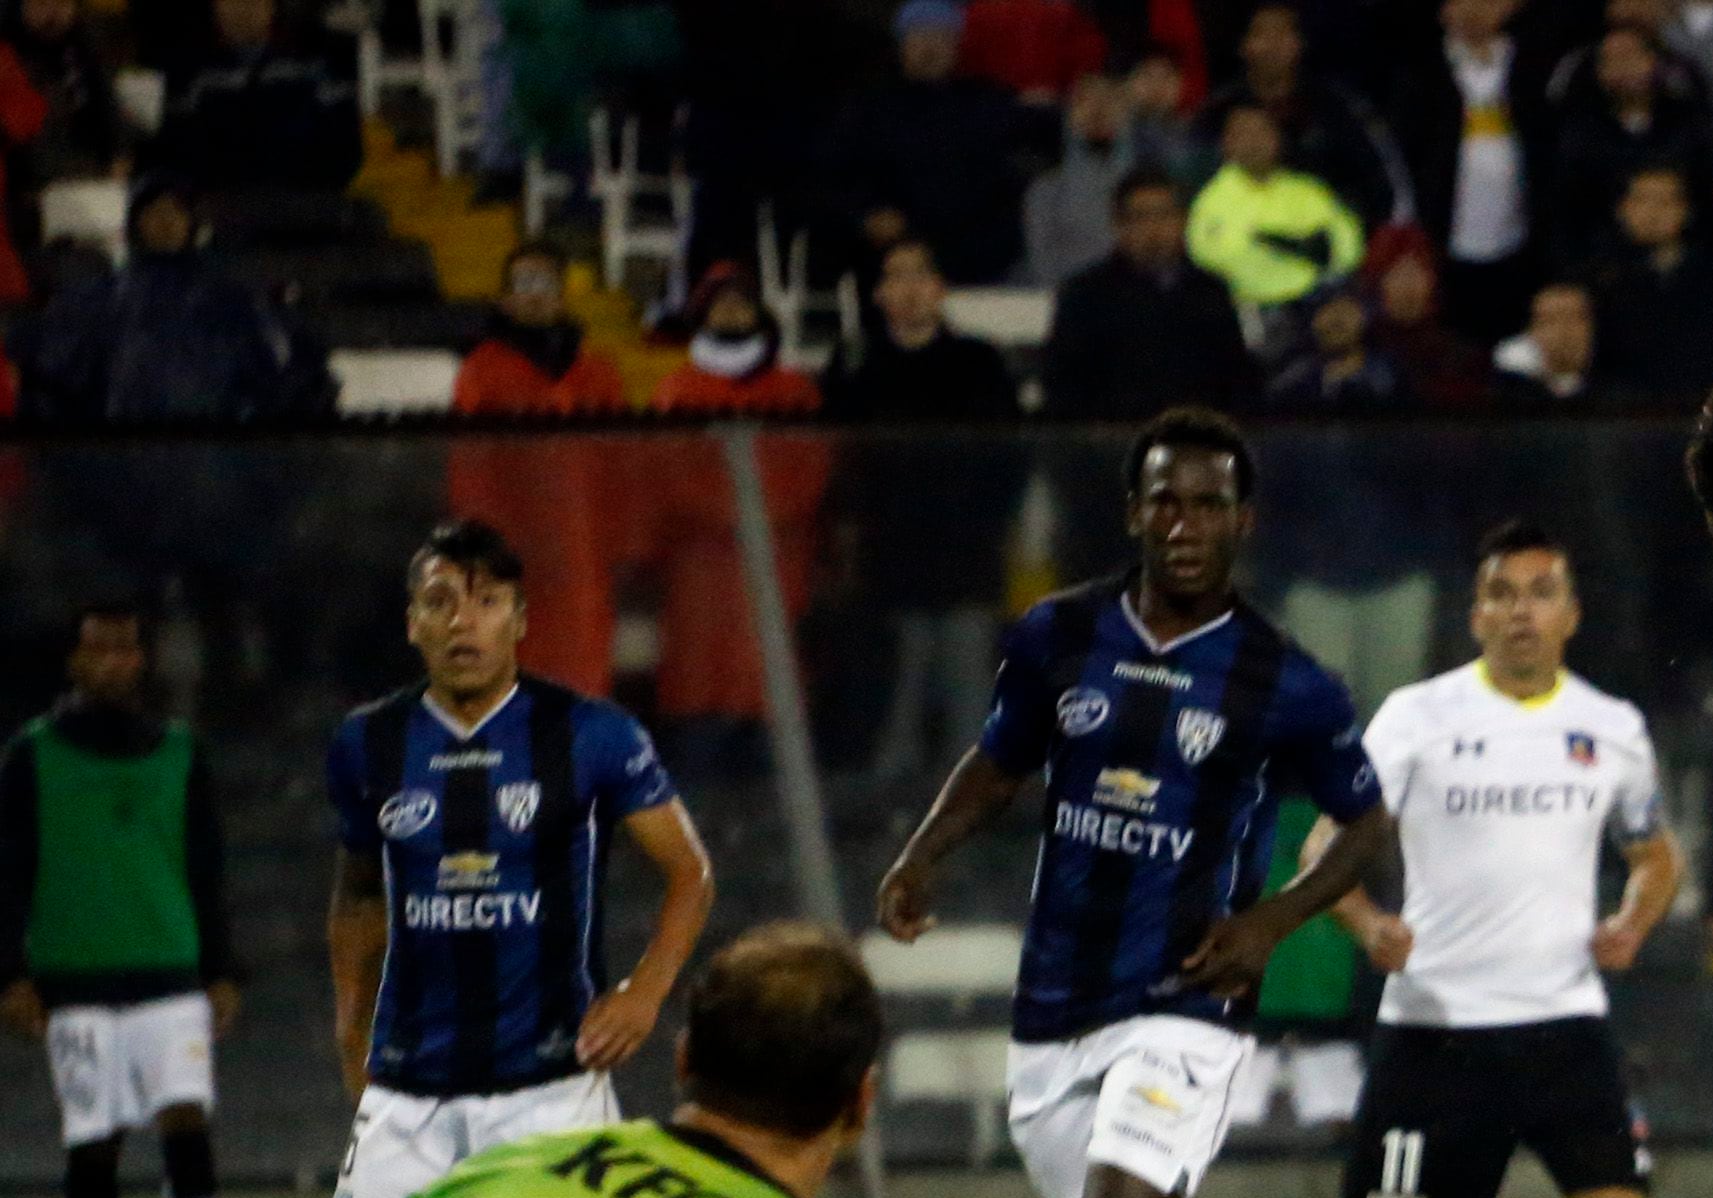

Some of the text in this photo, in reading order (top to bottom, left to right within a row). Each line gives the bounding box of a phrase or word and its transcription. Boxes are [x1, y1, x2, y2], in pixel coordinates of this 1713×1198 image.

[1445, 783, 1597, 814] DIRECTV
[1054, 800, 1194, 863] DIRECTV
[404, 888, 541, 931] DIRECTV
[1381, 1127, 1425, 1194] 11
